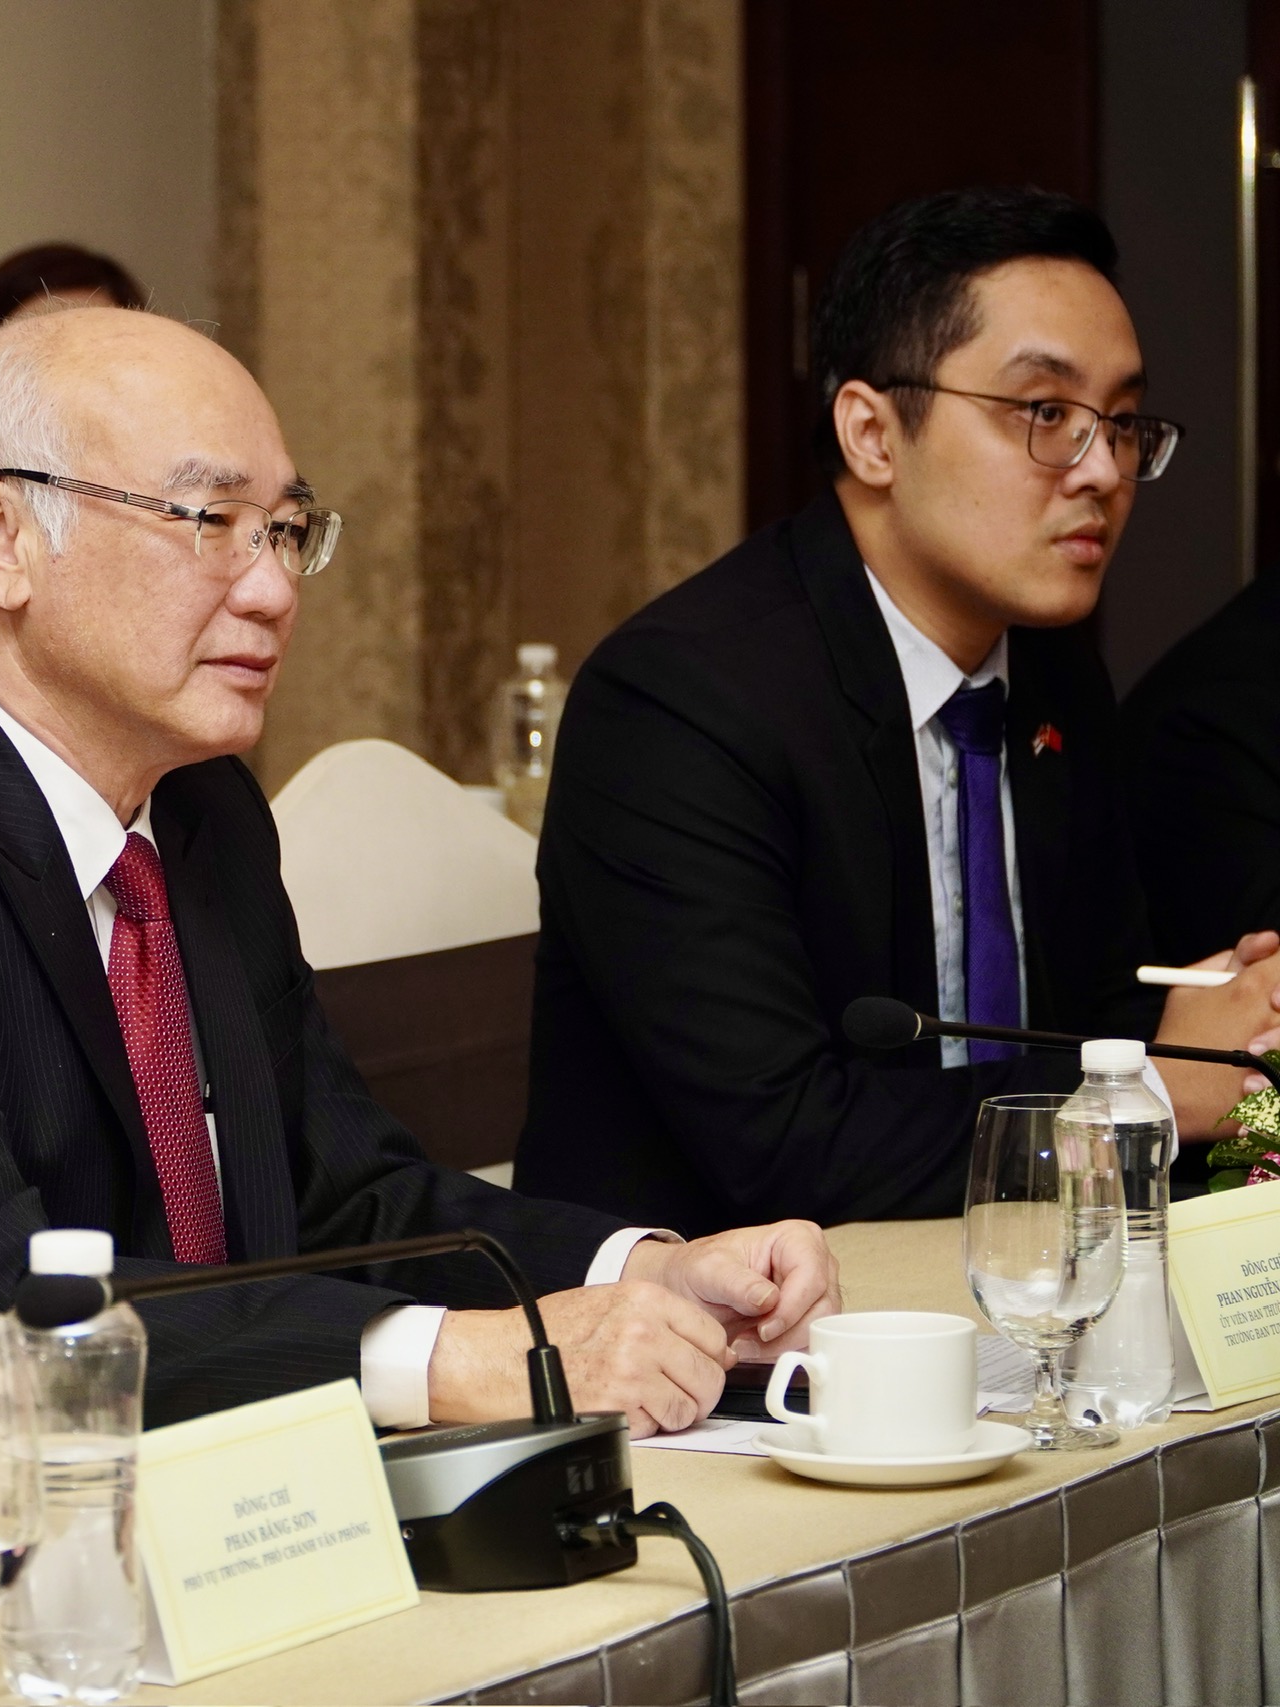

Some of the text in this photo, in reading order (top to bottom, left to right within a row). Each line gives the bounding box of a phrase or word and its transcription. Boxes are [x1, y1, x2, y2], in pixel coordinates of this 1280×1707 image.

[1216, 1288, 1244, 1307] PHAN
[1248, 1308, 1264, 1322] BAN
[1254, 1325, 1270, 1340] BAN
